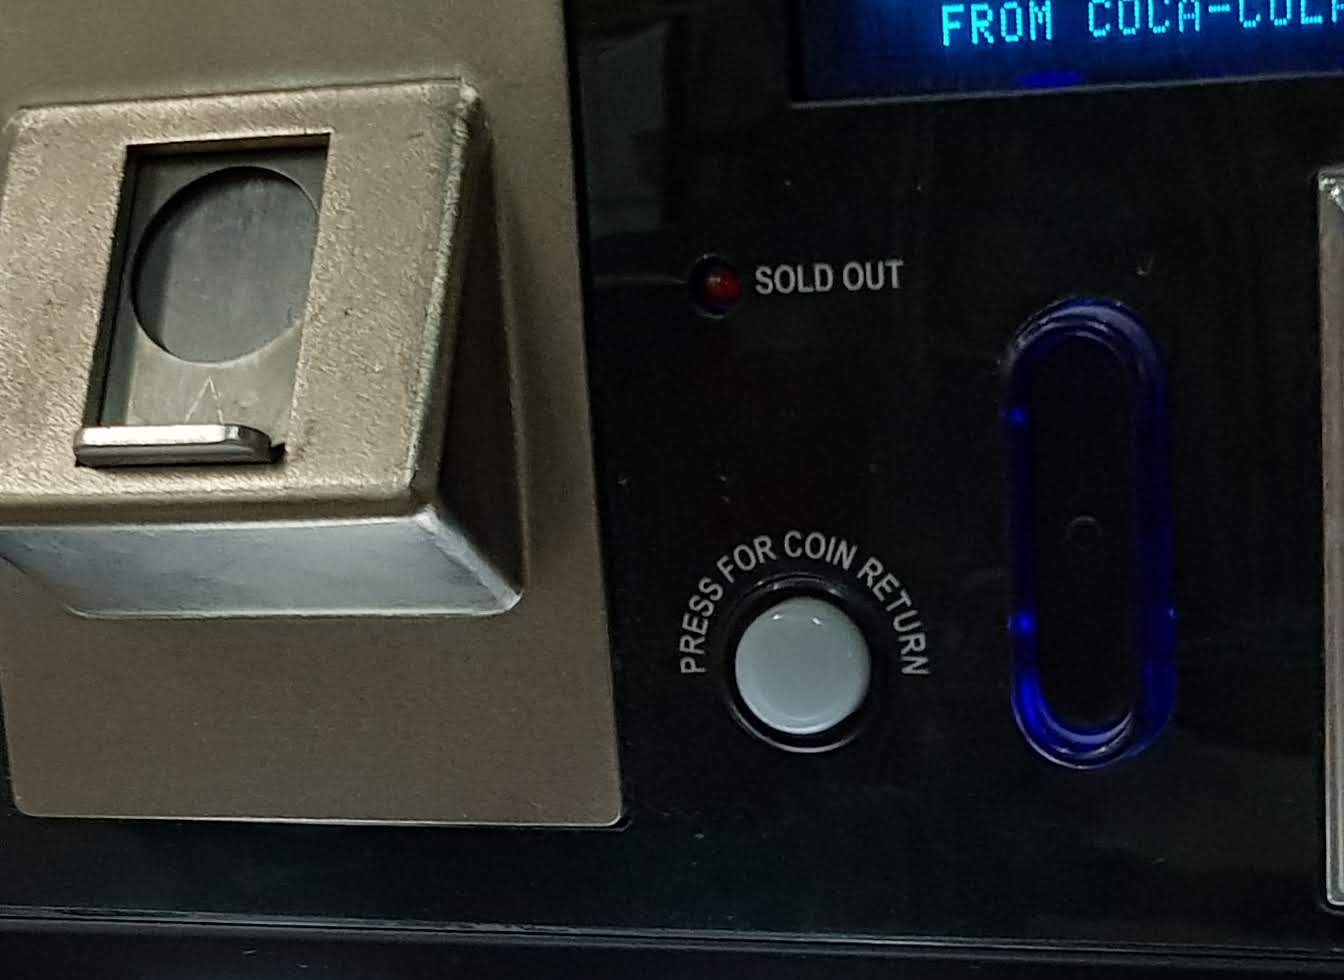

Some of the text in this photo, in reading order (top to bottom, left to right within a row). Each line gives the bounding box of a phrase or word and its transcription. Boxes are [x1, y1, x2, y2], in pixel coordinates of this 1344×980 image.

[942, 3, 1053, 47] FROM
[755, 259, 905, 295] SOLD OUT
[679, 530, 931, 676] PRESS FOR COIN RETURN
